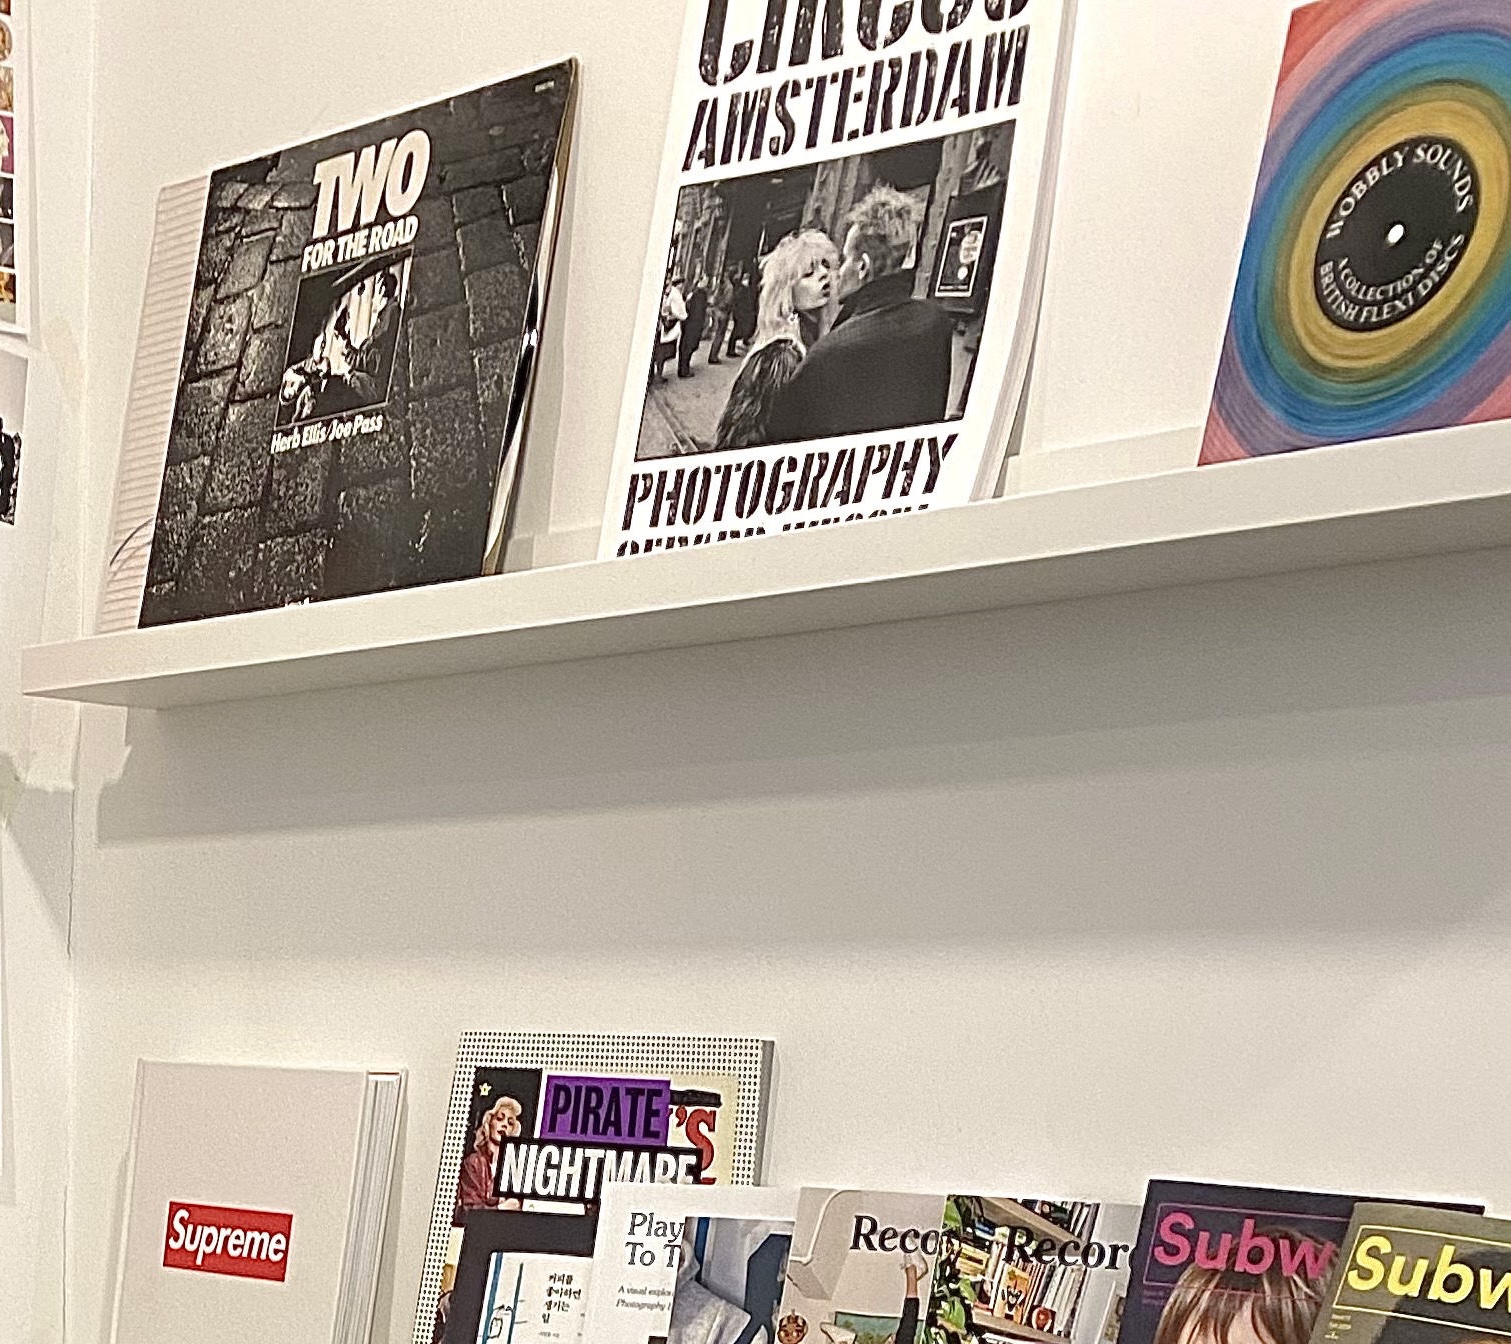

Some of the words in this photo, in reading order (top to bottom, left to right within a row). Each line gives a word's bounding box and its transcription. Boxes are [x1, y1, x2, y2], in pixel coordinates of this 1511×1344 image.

[681, 24, 1031, 173] AMSTERDAM
[312, 129, 431, 240] TWO
[1326, 146, 1409, 240] WOBBLY
[1412, 143, 1474, 214] SOUNDS
[301, 239, 336, 273] FOR
[337, 227, 369, 263] THE
[368, 215, 419, 253] ROAD
[1320, 261, 1359, 322] BRITISH
[1359, 292, 1415, 323] FLEXI
[1416, 233, 1465, 298] DISCS
[1340, 263, 1425, 301] COLLECTION
[270, 426, 301, 454] Herb
[621, 432, 960, 531] PHOTOGRAPHY
[547, 1083, 664, 1139] PIRATE
[169, 1208, 287, 1266] Supreme
[625, 1241, 656, 1267] To
[627, 1212, 685, 1243] Play
[1002, 1225, 1137, 1271] Recor
[1153, 1212, 1339, 1280] Subw
